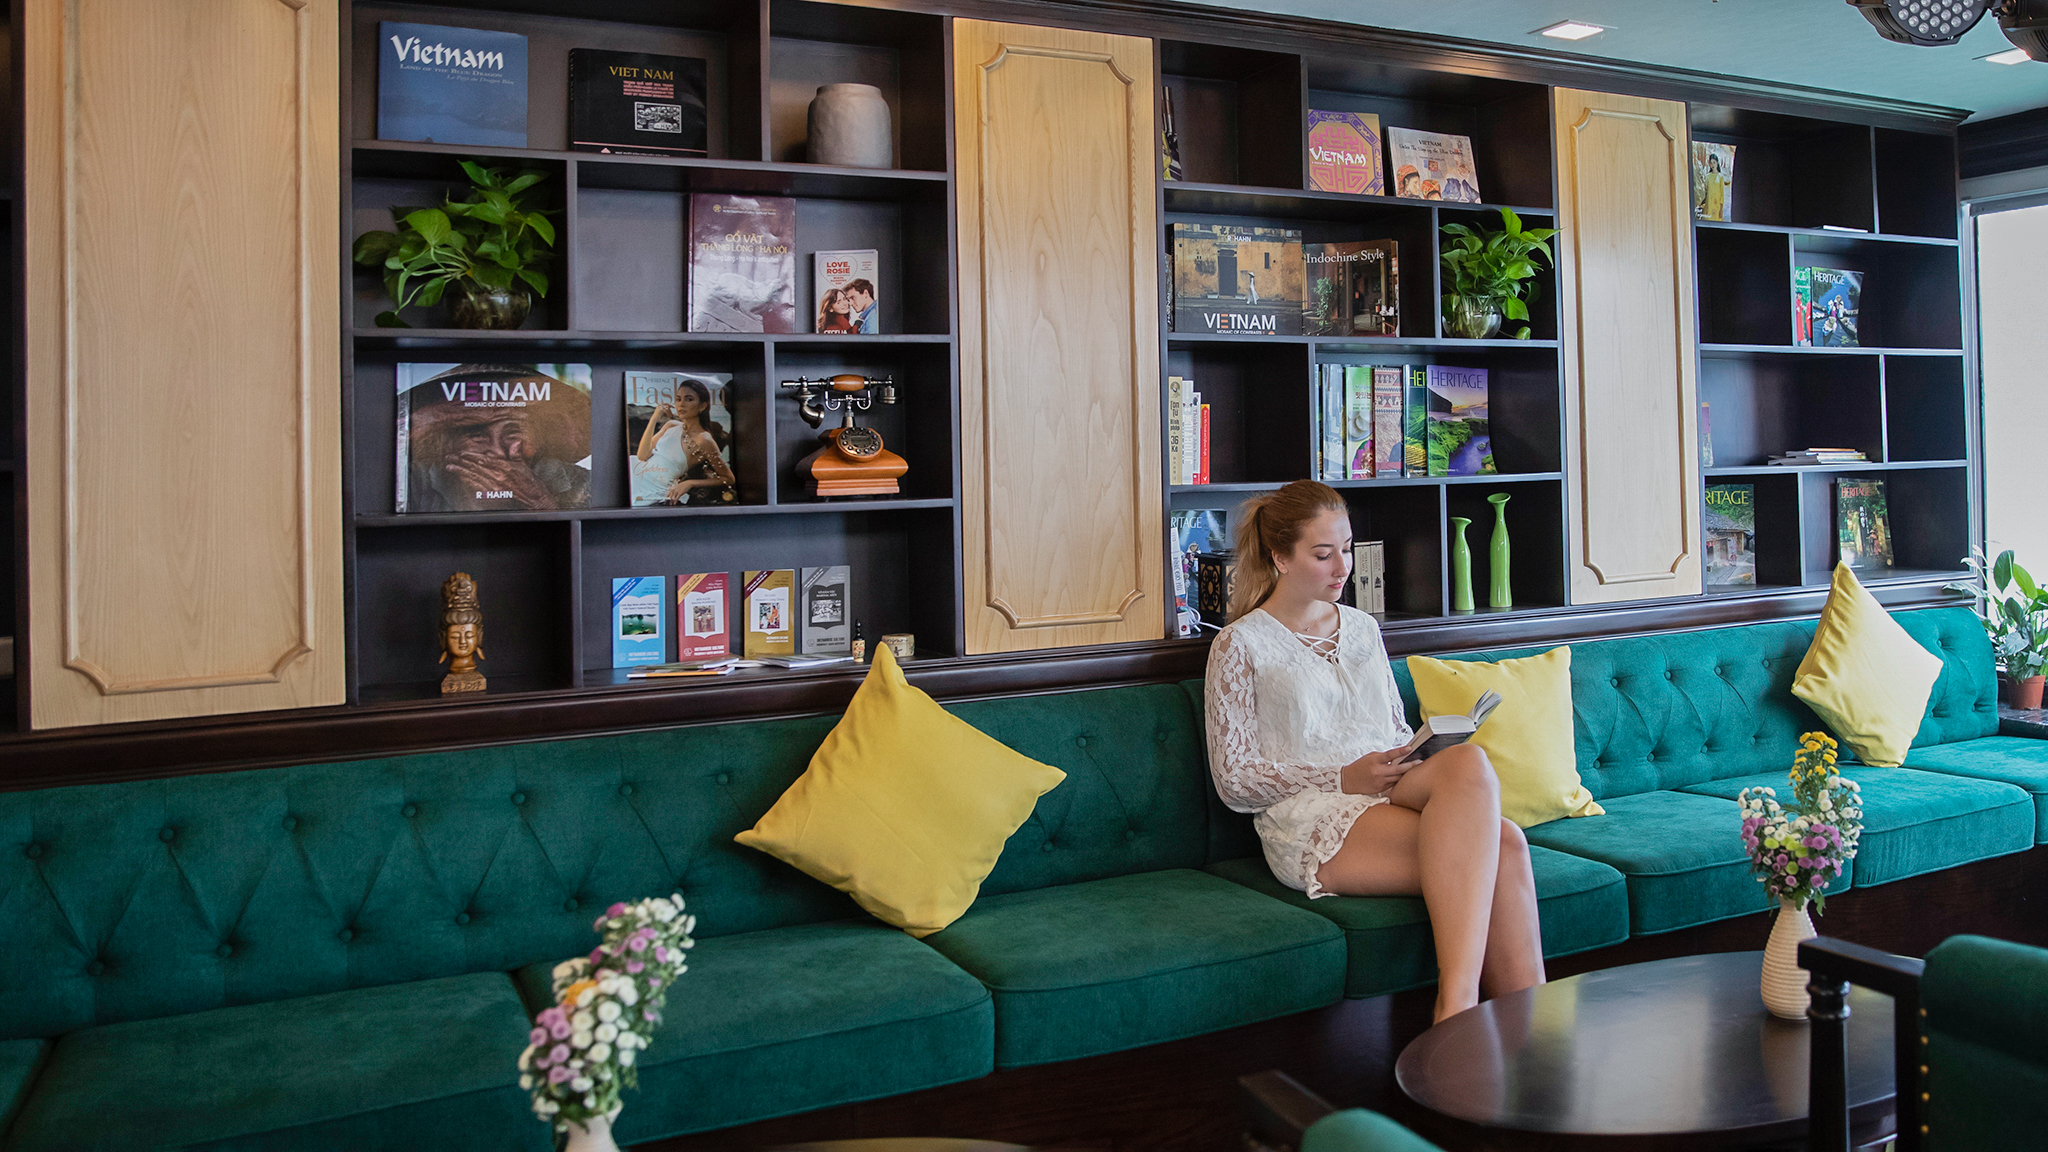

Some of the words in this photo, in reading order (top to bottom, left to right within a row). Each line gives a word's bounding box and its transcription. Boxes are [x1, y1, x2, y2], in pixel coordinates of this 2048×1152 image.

[390, 35, 504, 70] Vietnam
[609, 66, 639, 78] VIET
[644, 69, 674, 80] NAM
[1309, 146, 1366, 167] VIETNAM
[732, 244, 754, 253] LONG
[1306, 251, 1358, 264] Indochine
[1360, 248, 1385, 263] Style
[1814, 271, 1845, 285] HERITAGE
[1204, 313, 1276, 330] VIETNAM
[1431, 370, 1484, 389] HERITAGE
[441, 382, 550, 402] VIETNAM
[1171, 435, 1179, 445] 36
[1841, 486, 1870, 497] HERITAGE
